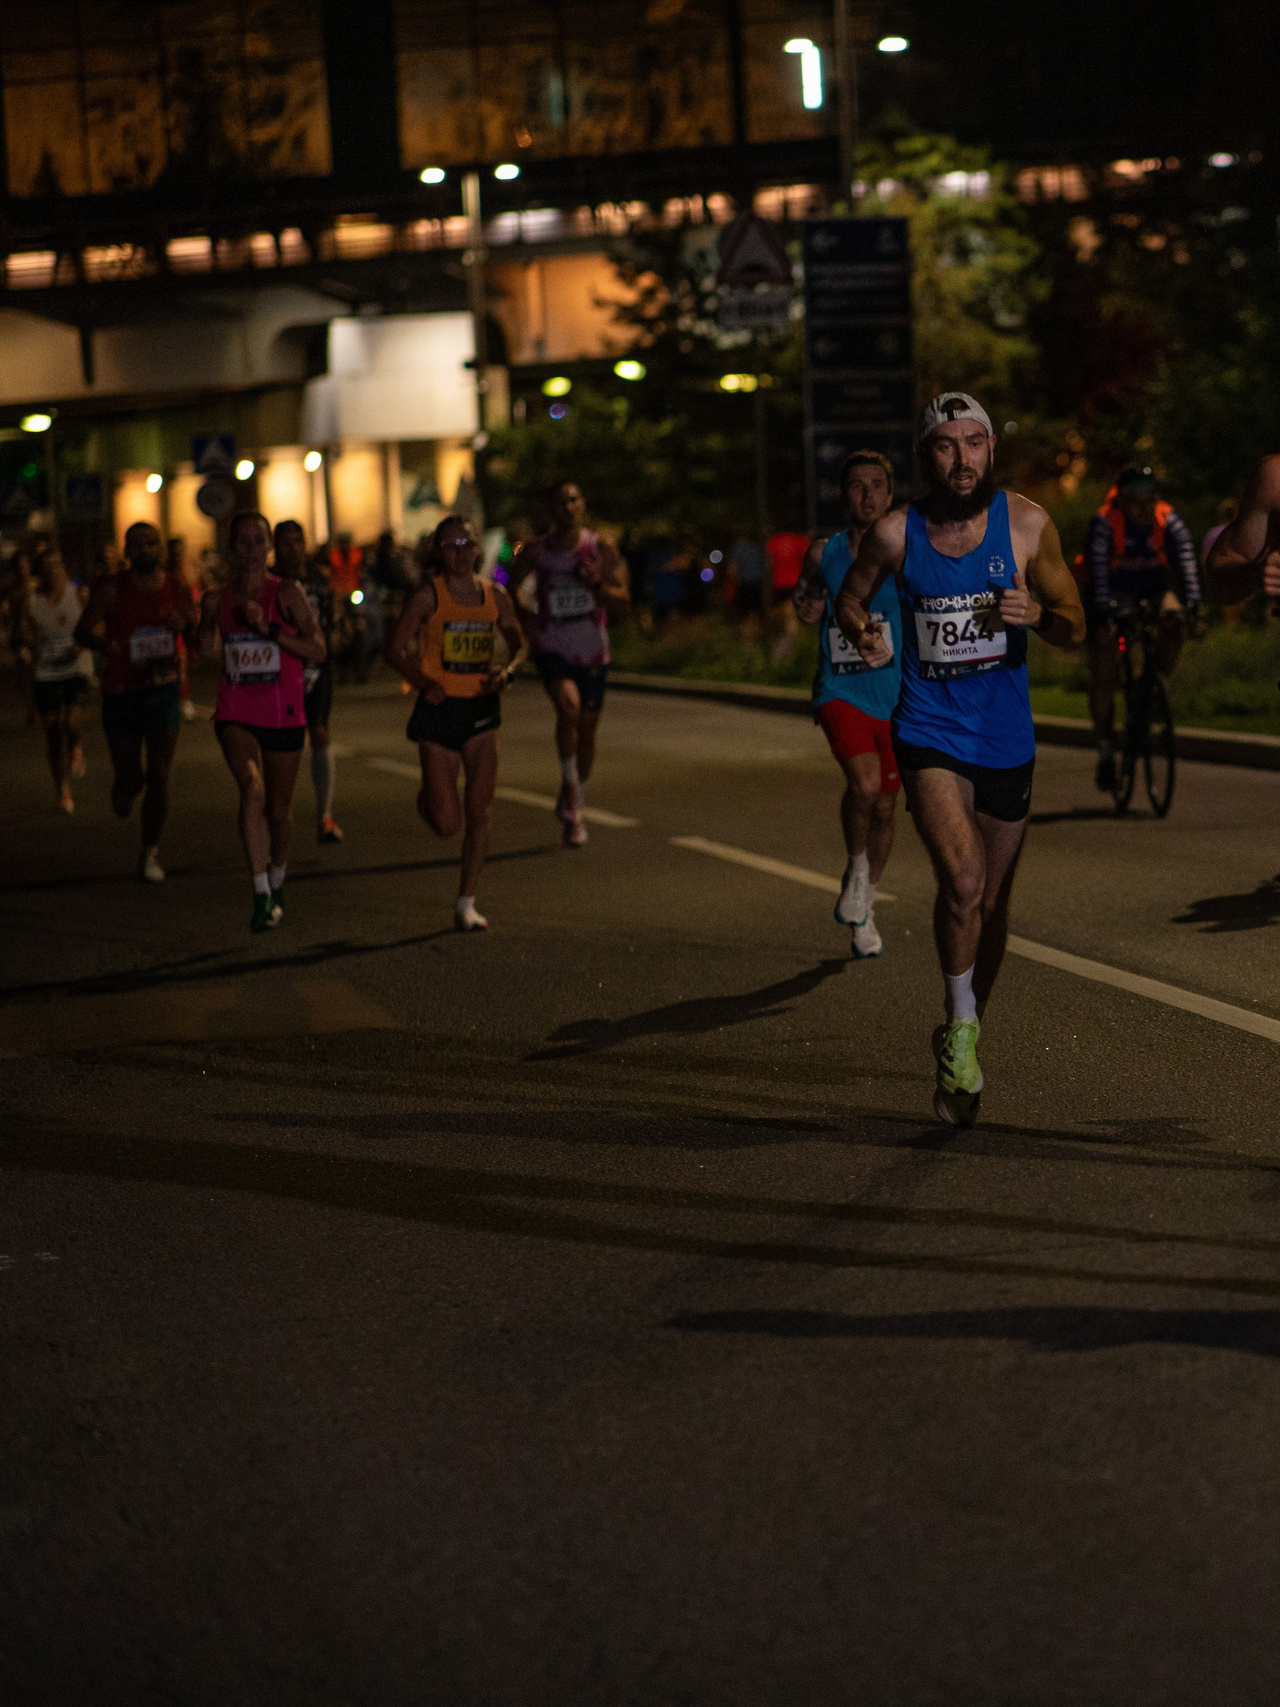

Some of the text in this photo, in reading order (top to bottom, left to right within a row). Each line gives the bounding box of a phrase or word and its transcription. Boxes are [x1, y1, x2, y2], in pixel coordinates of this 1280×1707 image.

[922, 592, 997, 610] НОЧНОЙ
[926, 618, 995, 647] 7844
[942, 646, 979, 657] НИКИТА
